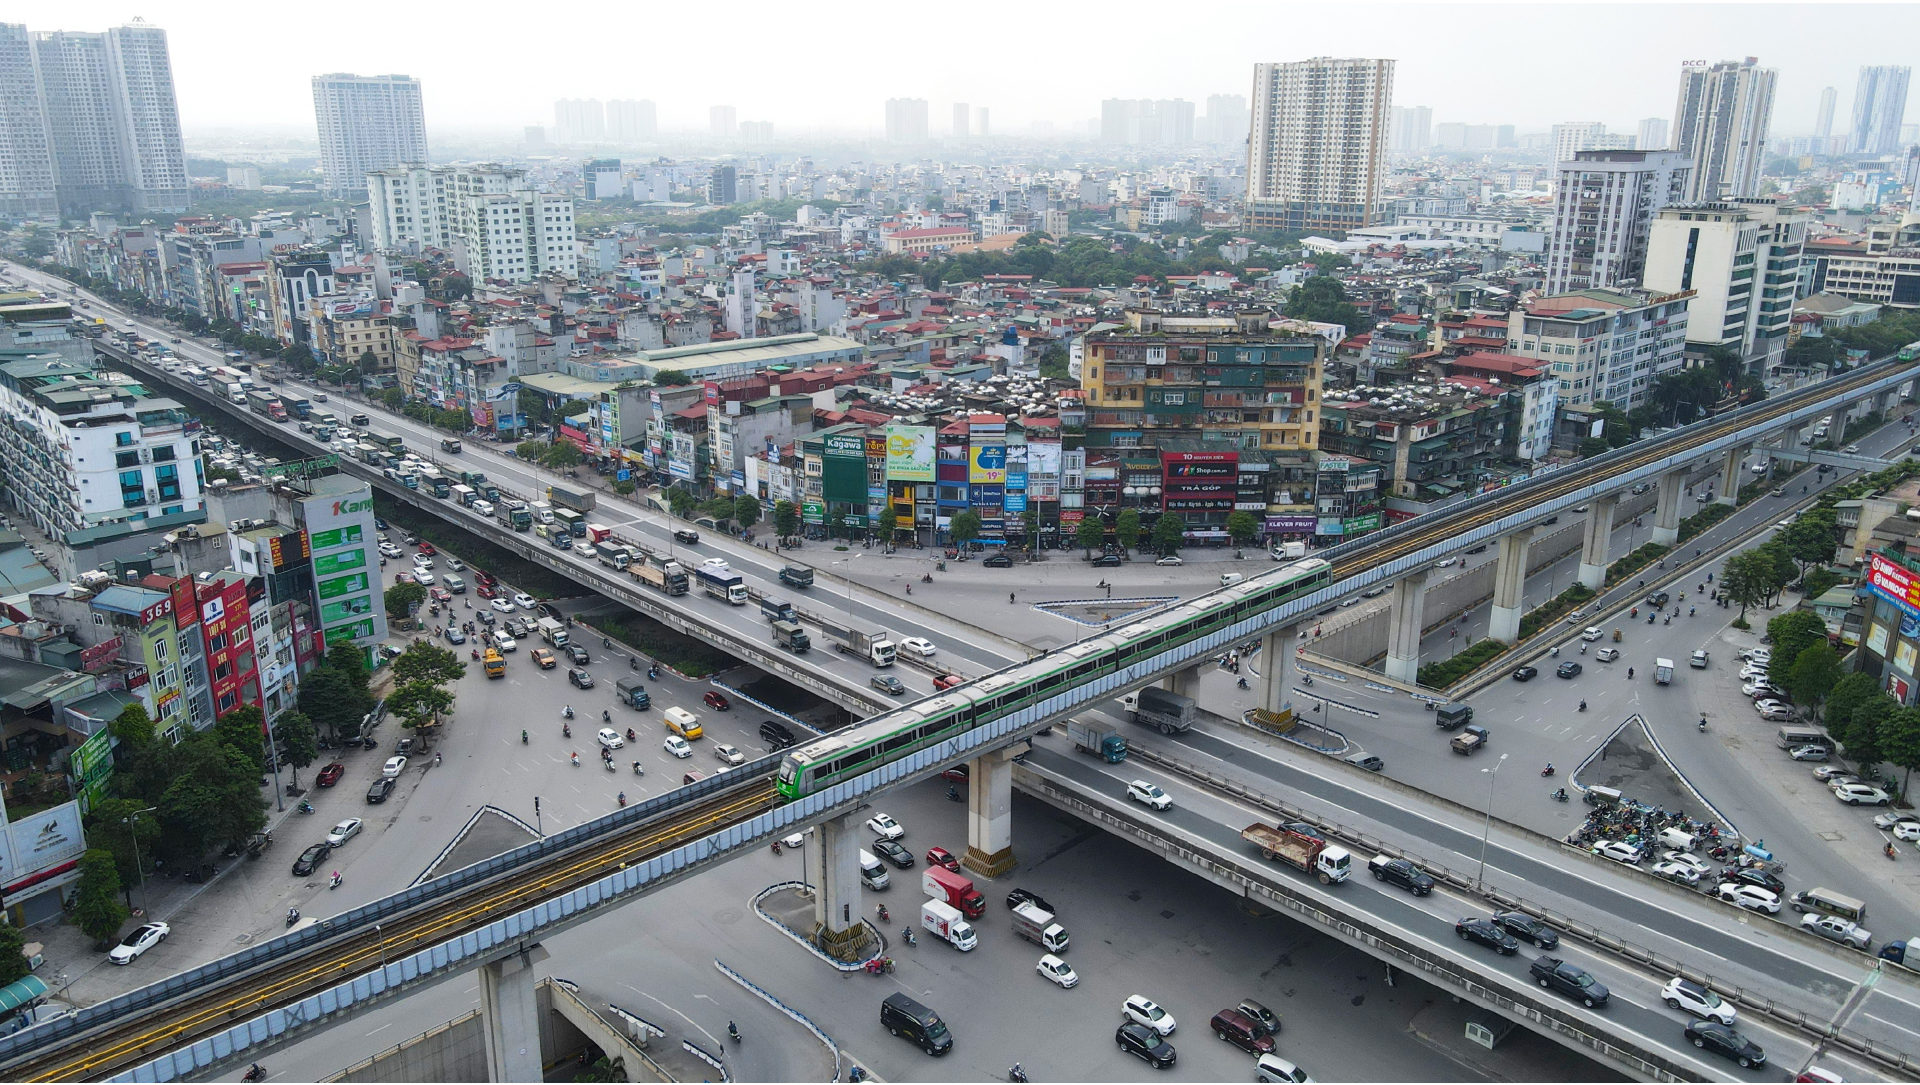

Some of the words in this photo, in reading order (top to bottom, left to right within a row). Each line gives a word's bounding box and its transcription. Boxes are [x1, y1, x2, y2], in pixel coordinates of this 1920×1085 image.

[274, 243, 301, 251] HOTEL
[827, 439, 861, 450] Kagawa
[1320, 461, 1347, 469] FASTER
[1178, 466, 1195, 474] FPT
[146, 600, 171, 622] 369
